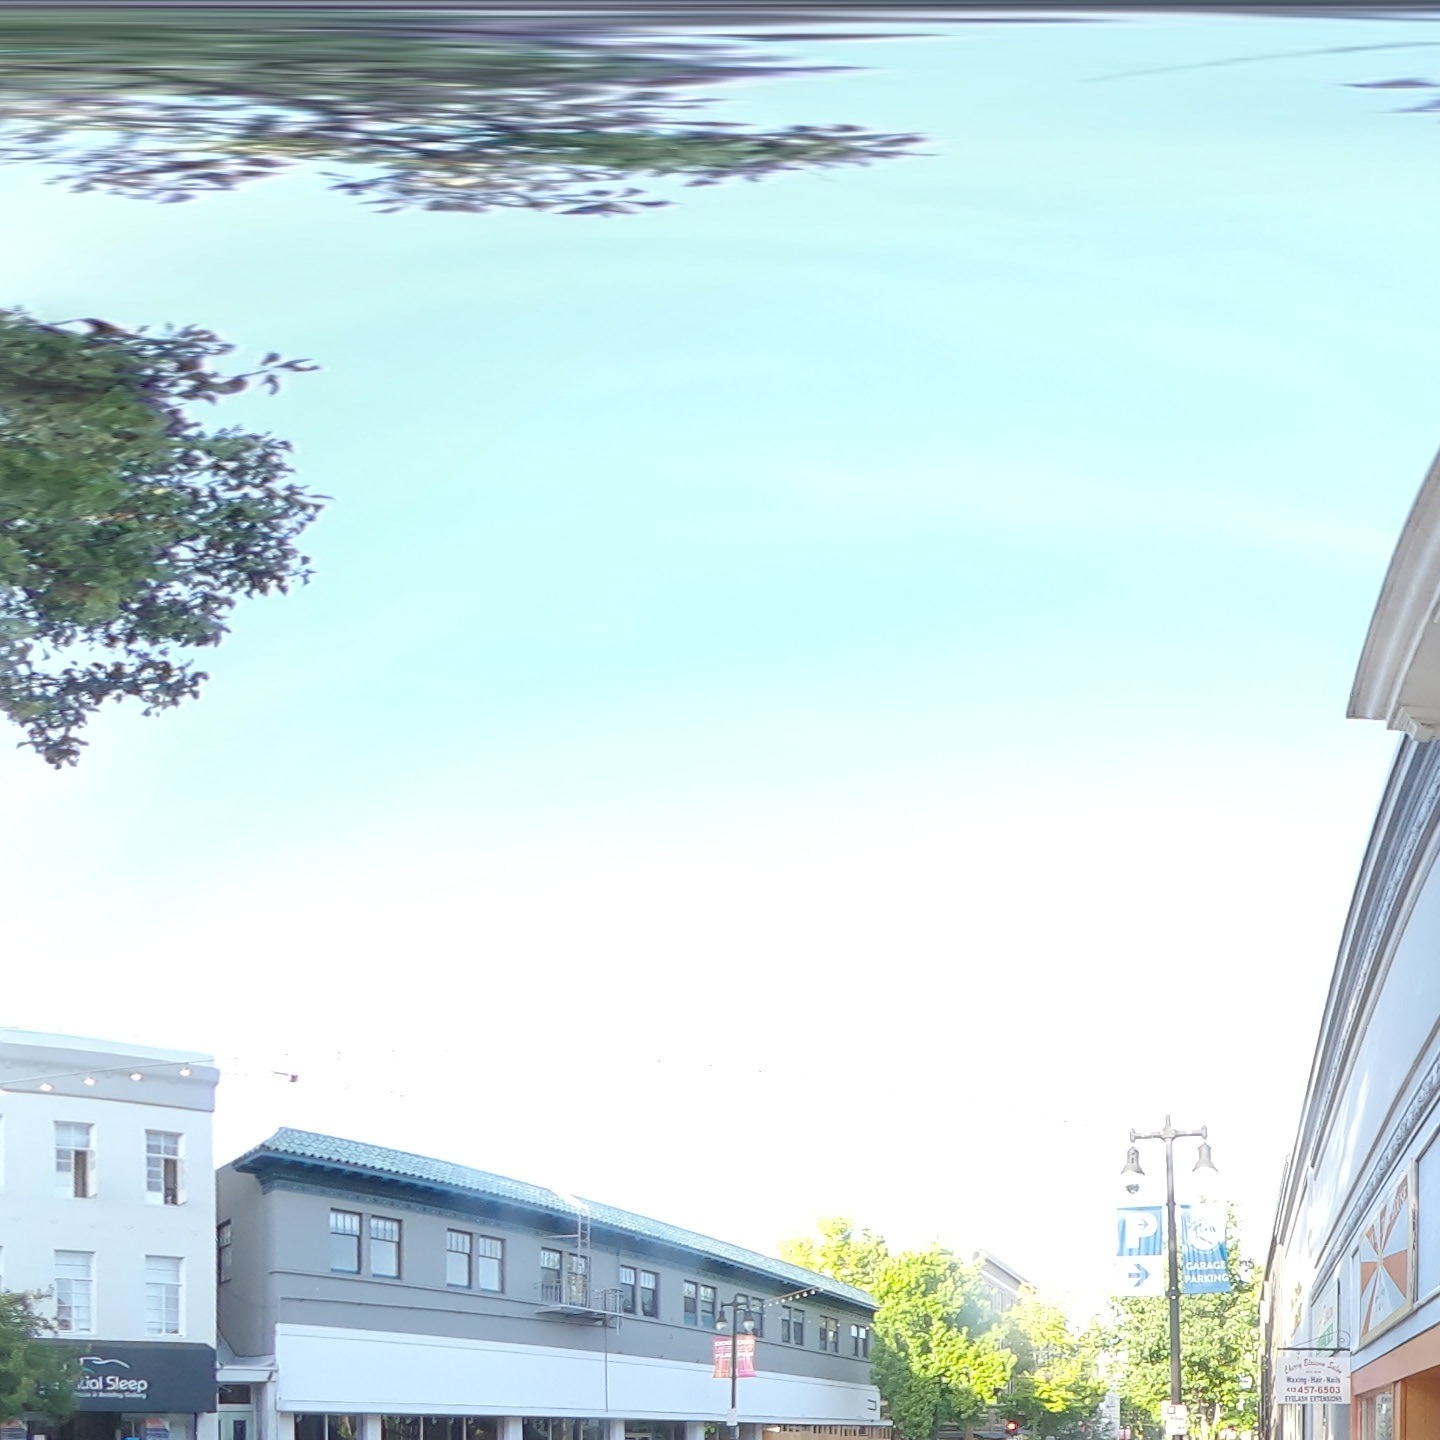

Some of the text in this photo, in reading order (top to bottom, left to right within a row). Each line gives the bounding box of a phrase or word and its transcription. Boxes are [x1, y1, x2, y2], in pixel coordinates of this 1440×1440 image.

[1185, 1261, 1227, 1271] GARAGE
[1184, 1273, 1229, 1284] PARKING
[106, 1375, 149, 1393] Sleep
[1297, 1386, 1341, 1394] 457-6503
